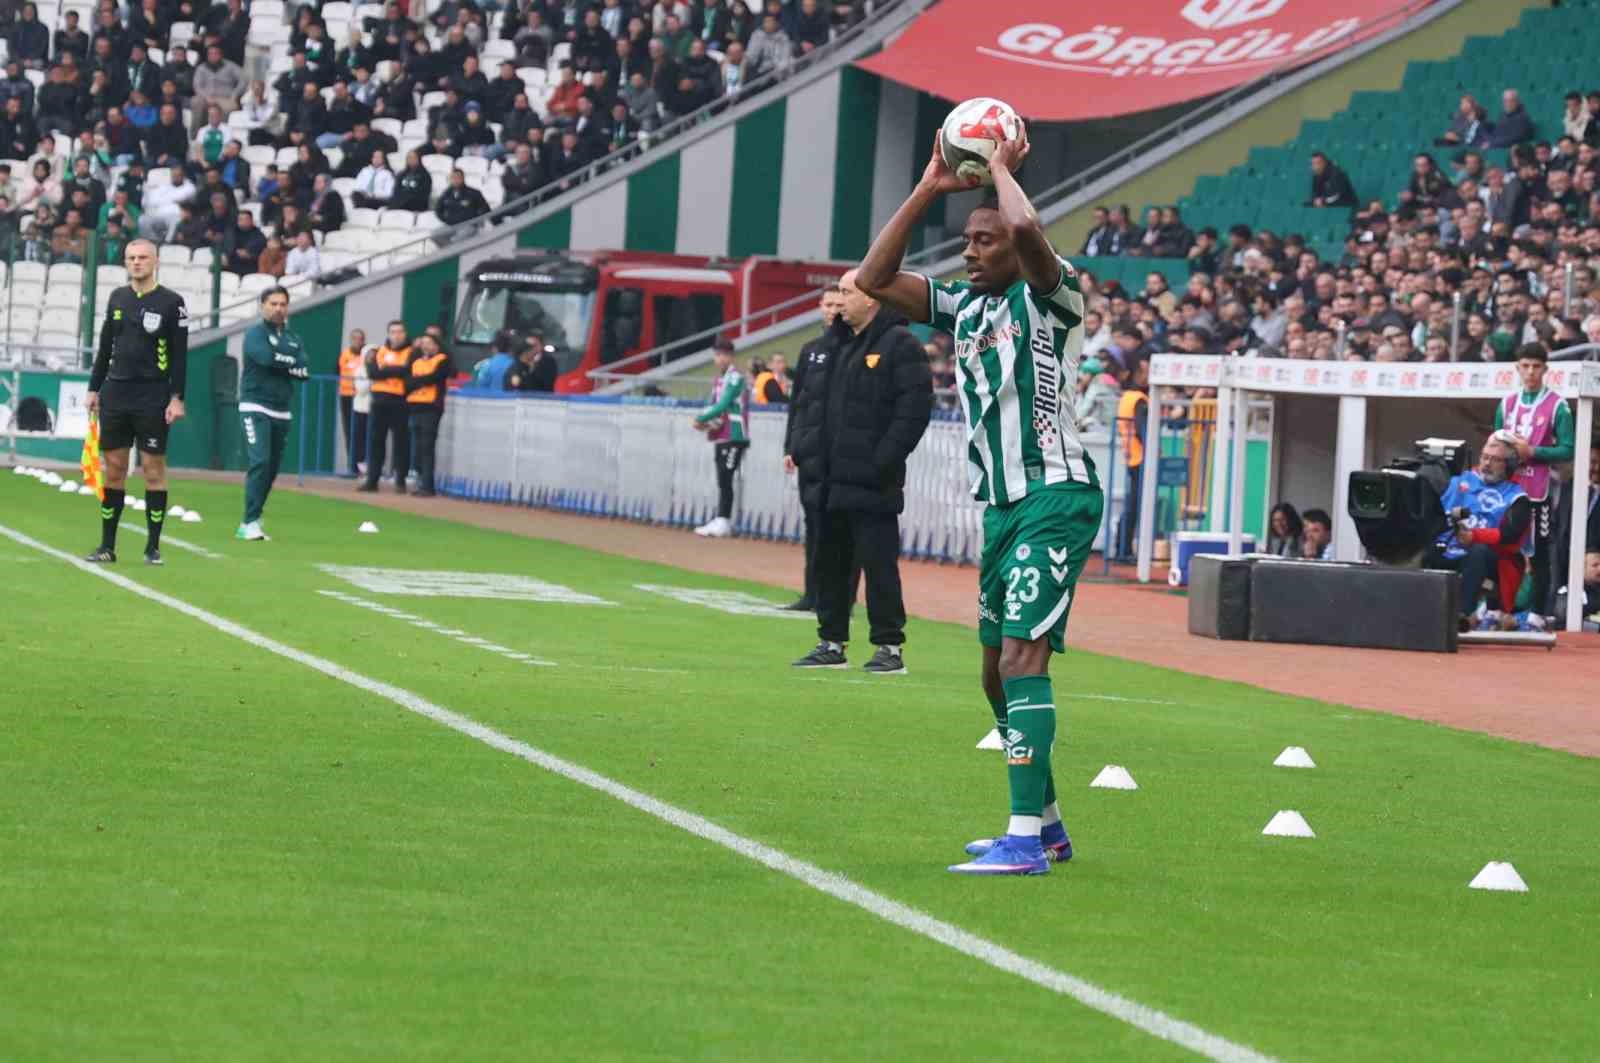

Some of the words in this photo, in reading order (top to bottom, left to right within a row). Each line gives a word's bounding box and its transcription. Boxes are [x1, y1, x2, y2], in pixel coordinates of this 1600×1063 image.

[996, 17, 1361, 65] GÖRGÜLÜ
[1031, 328, 1055, 358] Go
[1035, 361, 1057, 414] Rent
[1005, 566, 1041, 603] 23
